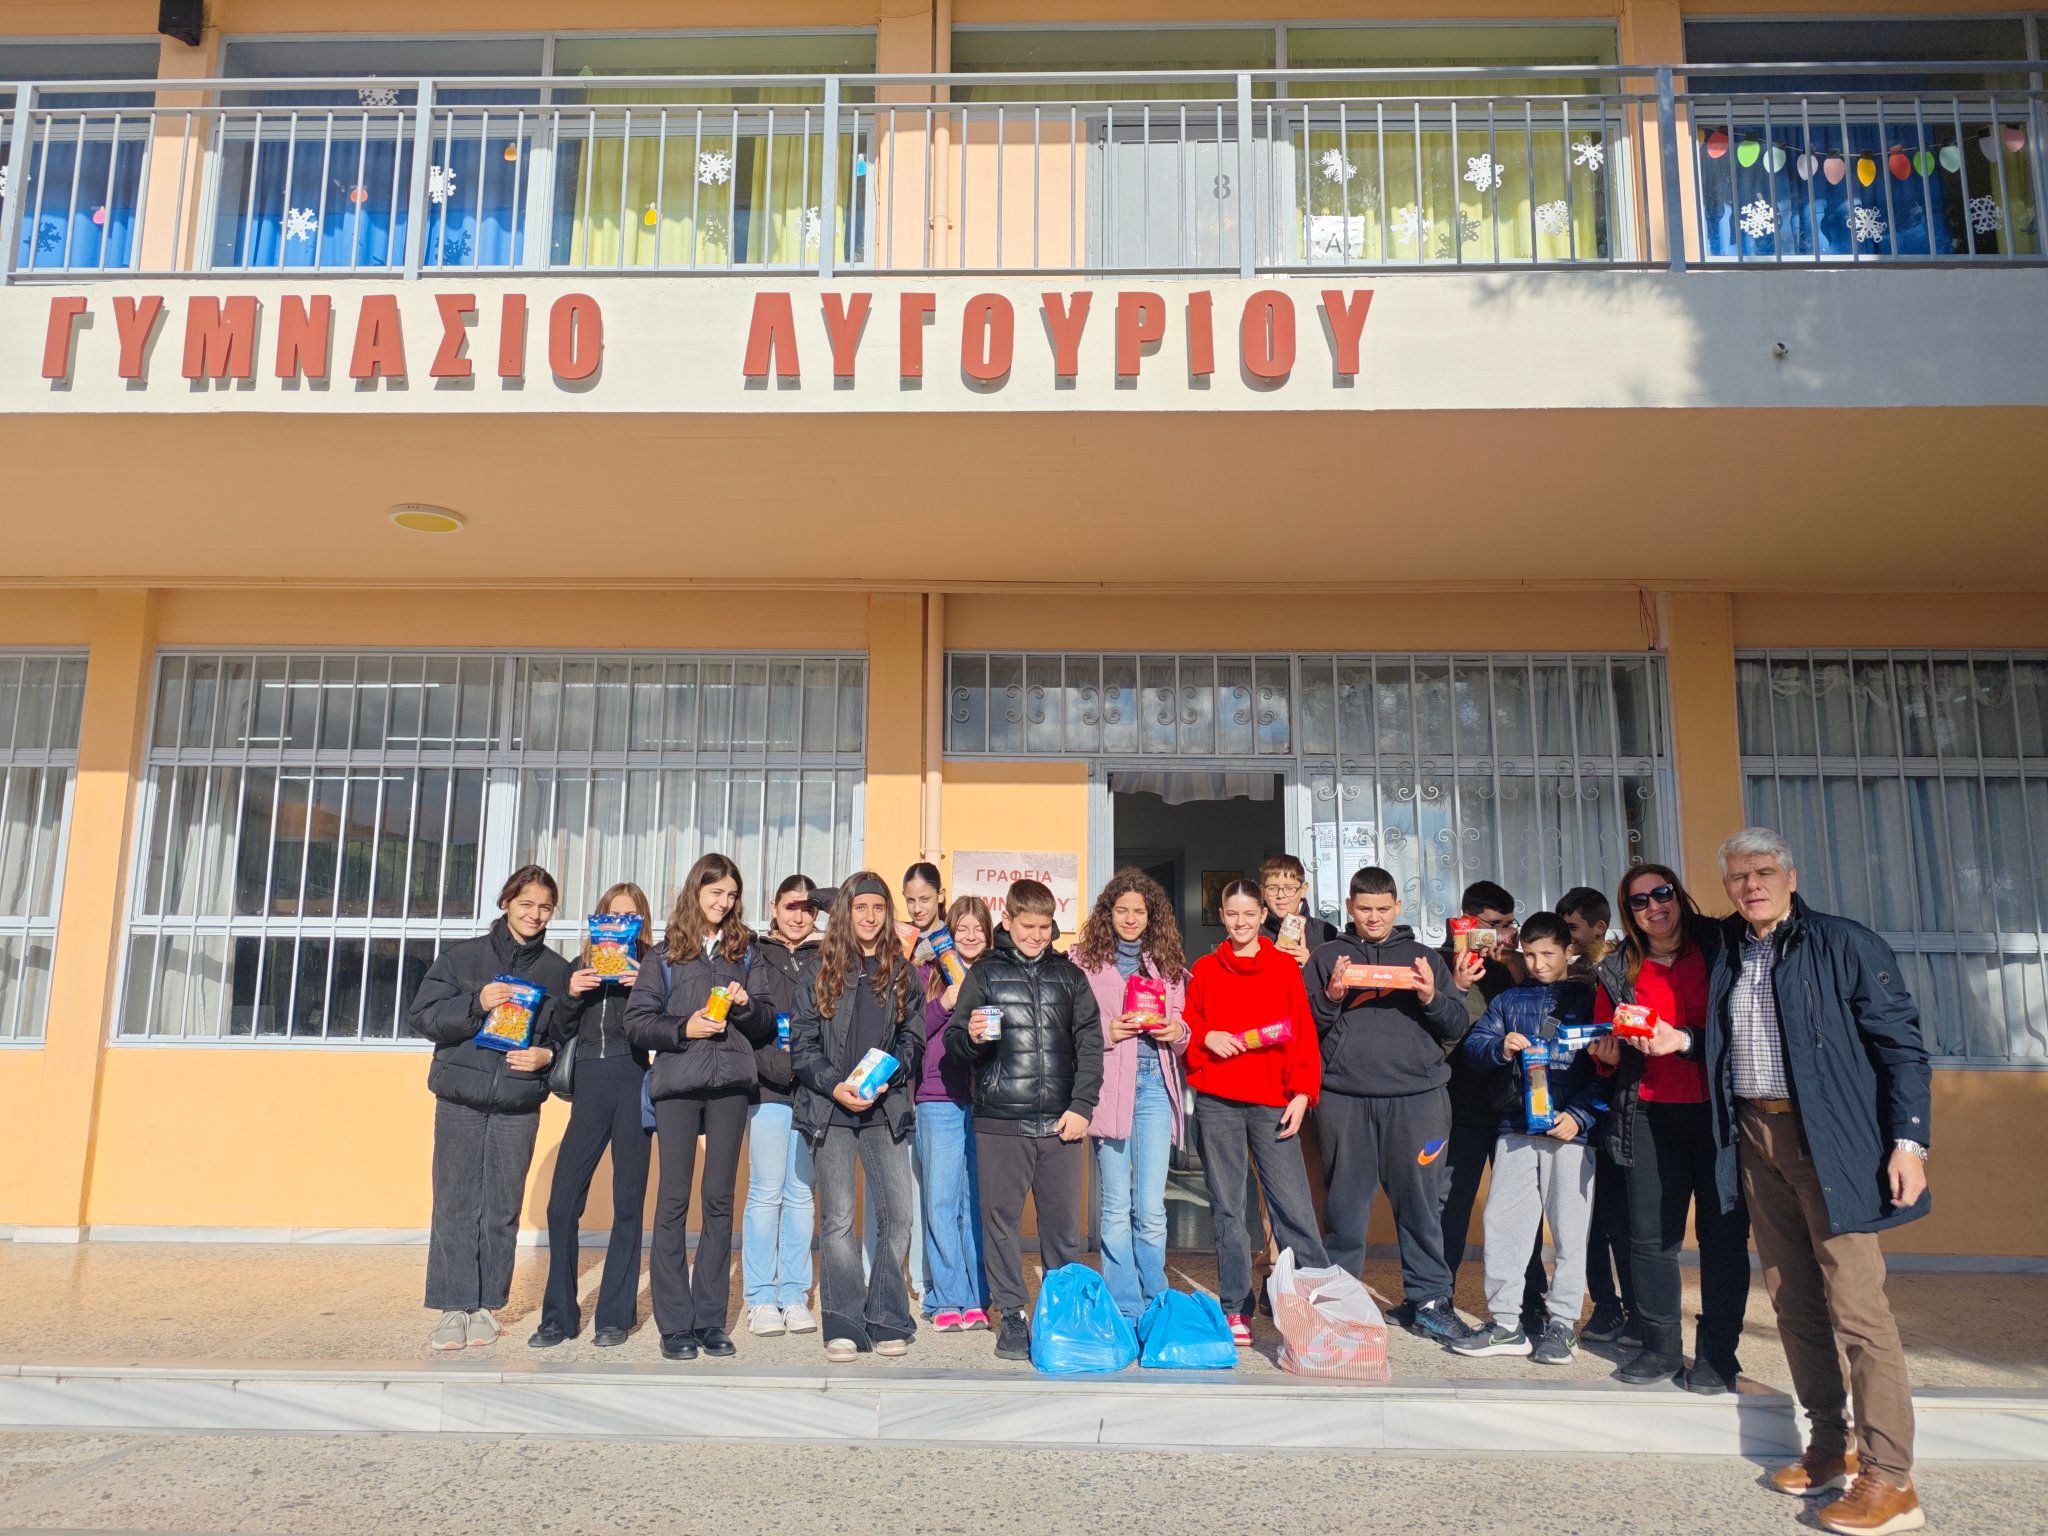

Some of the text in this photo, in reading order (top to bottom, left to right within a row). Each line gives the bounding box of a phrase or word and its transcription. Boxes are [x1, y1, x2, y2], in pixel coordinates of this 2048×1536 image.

[1213, 174, 1231, 200] 8
[42, 289, 1375, 381] ΓΥΜΝΑΣΙΟ ΛΥΓΟΥΡΙΟΥ
[976, 869, 1052, 883] ΓΡΑΦΕΙΑ
